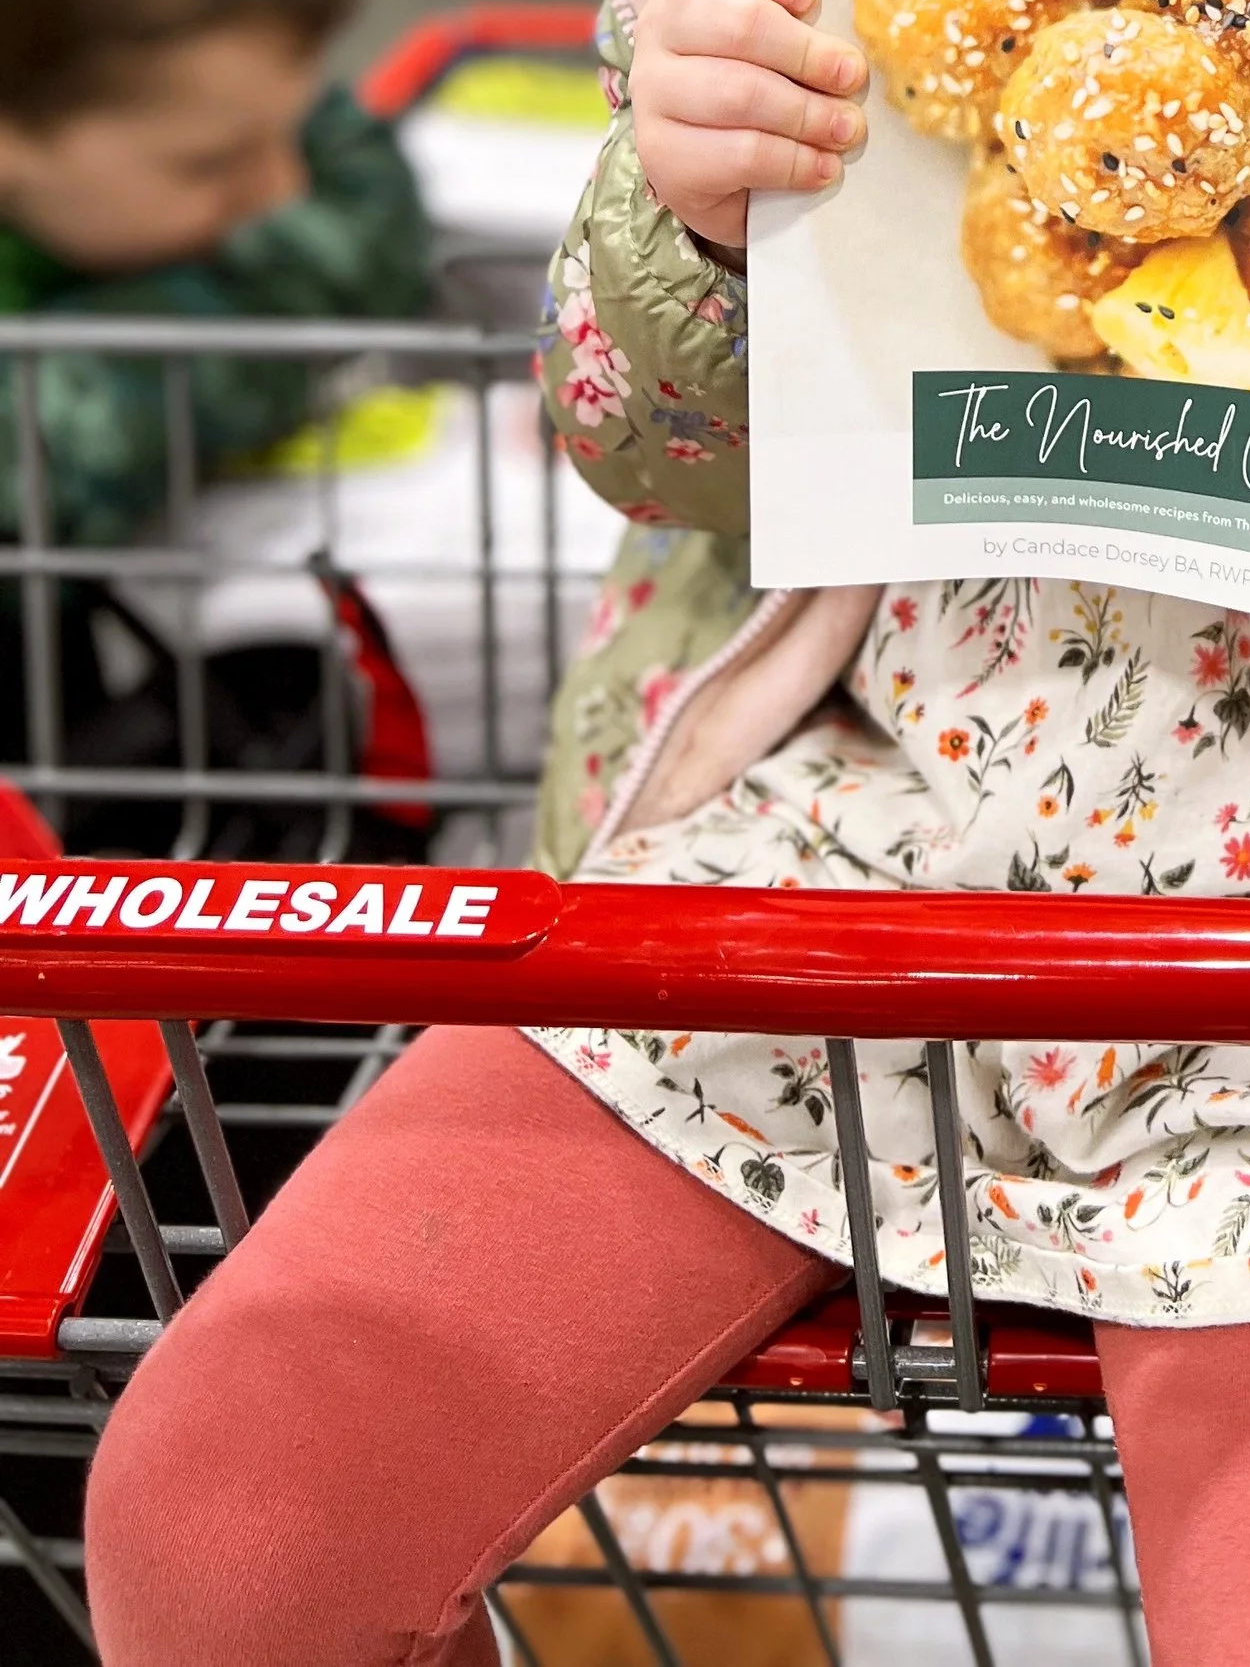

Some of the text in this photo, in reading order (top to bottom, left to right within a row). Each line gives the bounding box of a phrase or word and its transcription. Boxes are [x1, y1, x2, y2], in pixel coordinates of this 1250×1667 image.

[938, 382, 1010, 468] The
[1026, 384, 1236, 473] Nourished
[943, 492, 1010, 506] Delicious,
[1014, 494, 1048, 507] easy,
[1051, 493, 1076, 506] and
[1079, 495, 1151, 514] wholesome
[1153, 504, 1200, 522] recipes
[1202, 513, 1232, 528] from
[983, 537, 1008, 557] by
[1012, 538, 1100, 559] Candace
[1106, 544, 1170, 572] Dorsey
[1174, 555, 1203, 579] BA,
[0, 873, 499, 938] WHOLESALE
